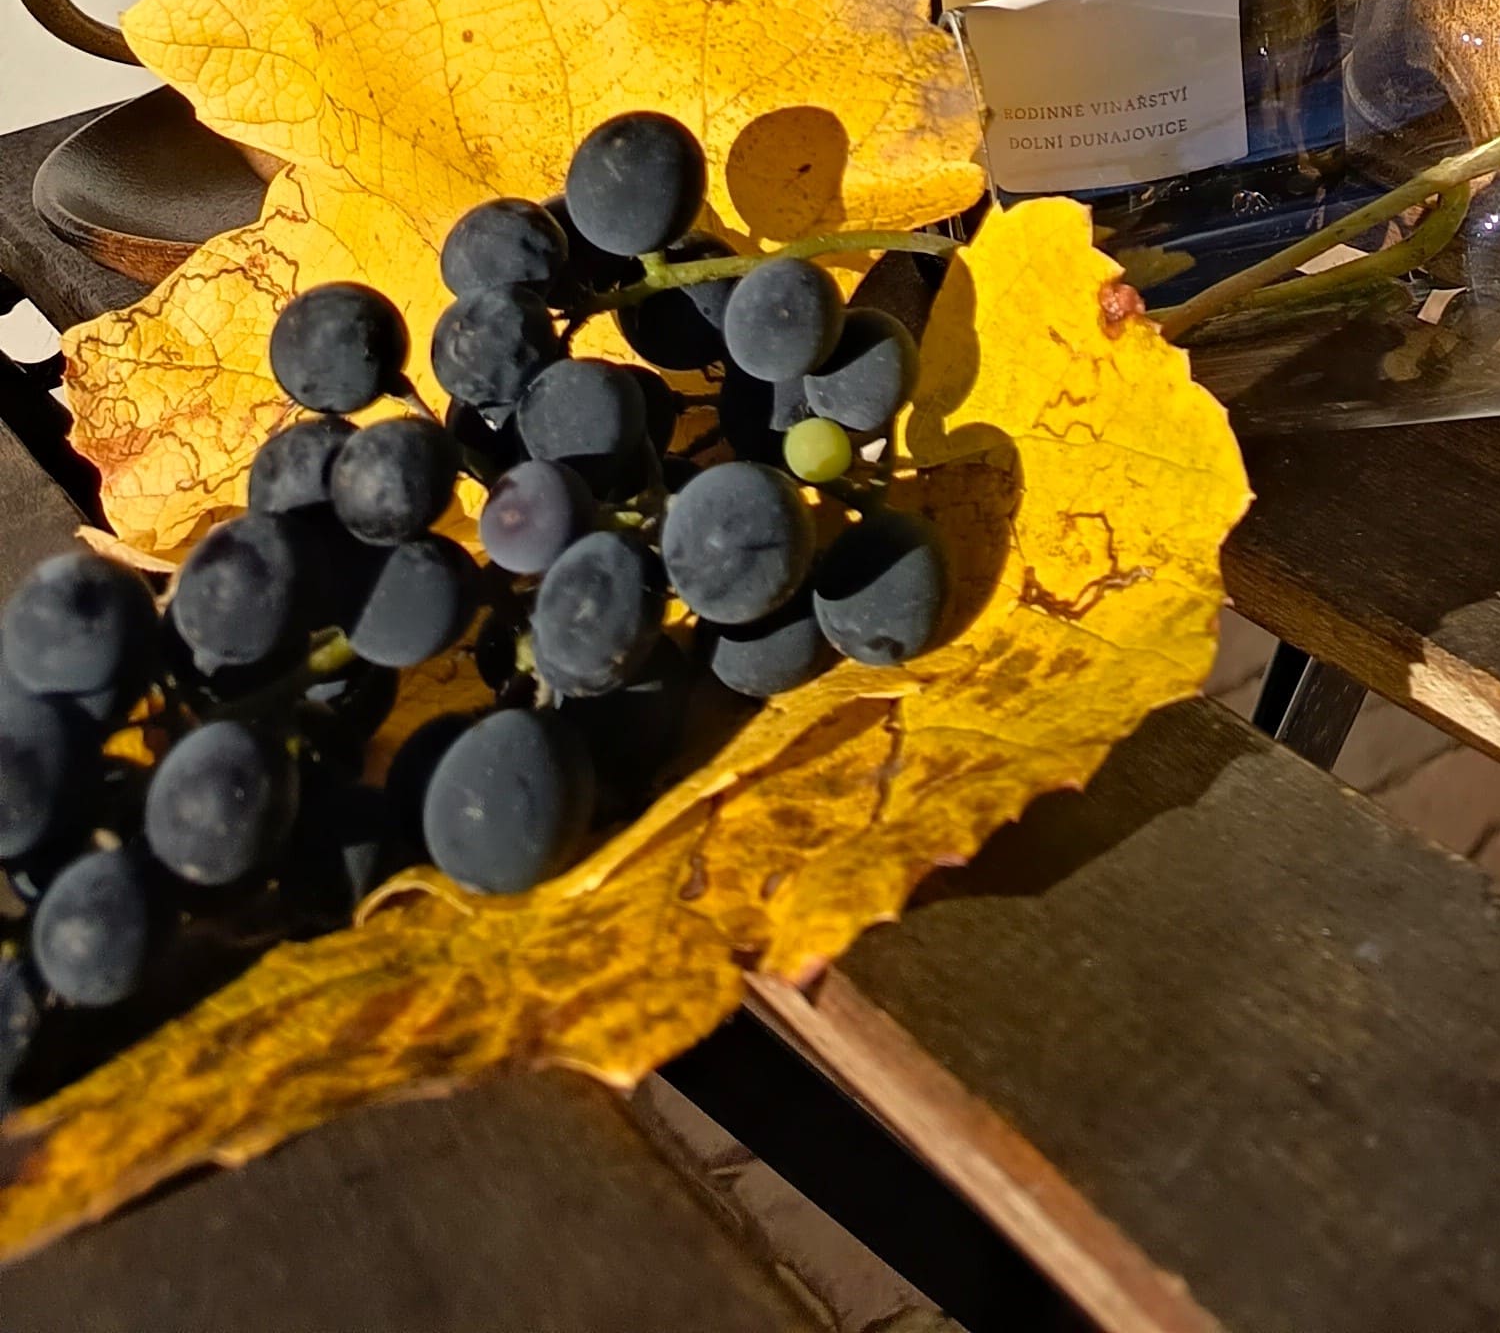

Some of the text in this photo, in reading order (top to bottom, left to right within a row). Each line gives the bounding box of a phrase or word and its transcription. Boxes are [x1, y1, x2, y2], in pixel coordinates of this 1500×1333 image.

[1004, 86, 1187, 121] RODINNÉ VINAŘSTVÍ
[1010, 119, 1188, 150] DOLNÍ DUNAJOVICE
